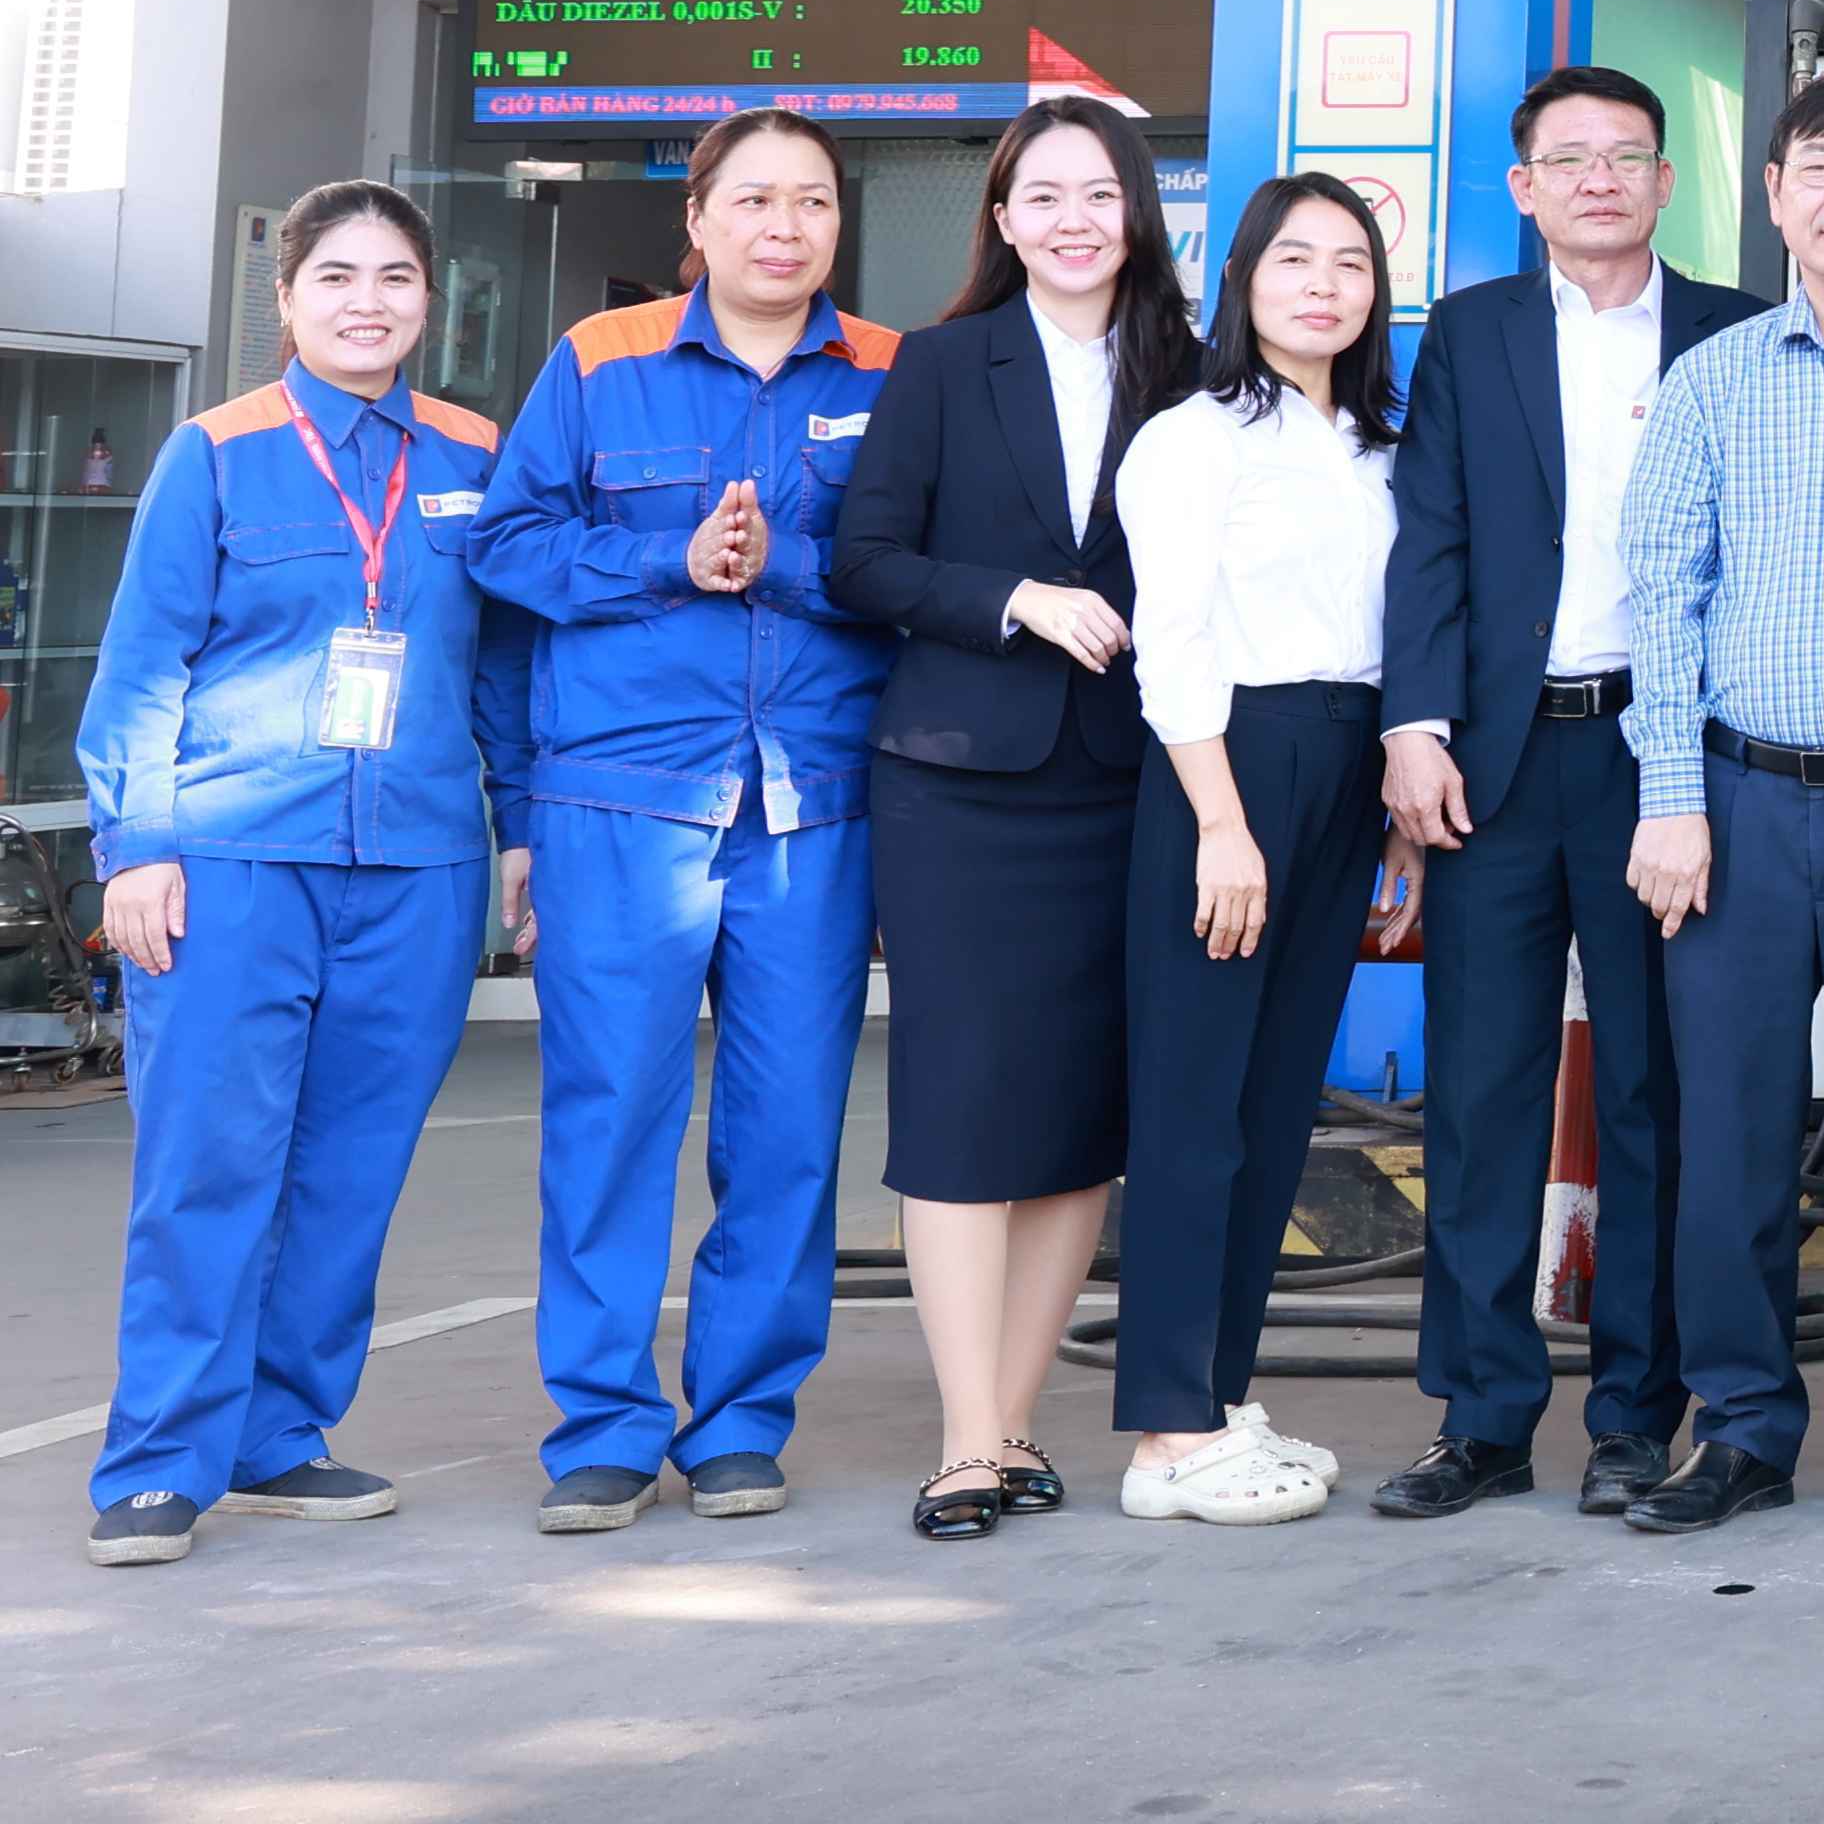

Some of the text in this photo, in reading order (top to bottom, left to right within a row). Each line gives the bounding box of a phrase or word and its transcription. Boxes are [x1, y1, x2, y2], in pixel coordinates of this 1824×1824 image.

[561, 2, 666, 22] DIEZEL
[672, 0, 784, 25] 0,001S-V
[901, 46, 982, 67] 19.860
[592, 94, 660, 114] HÀNG
